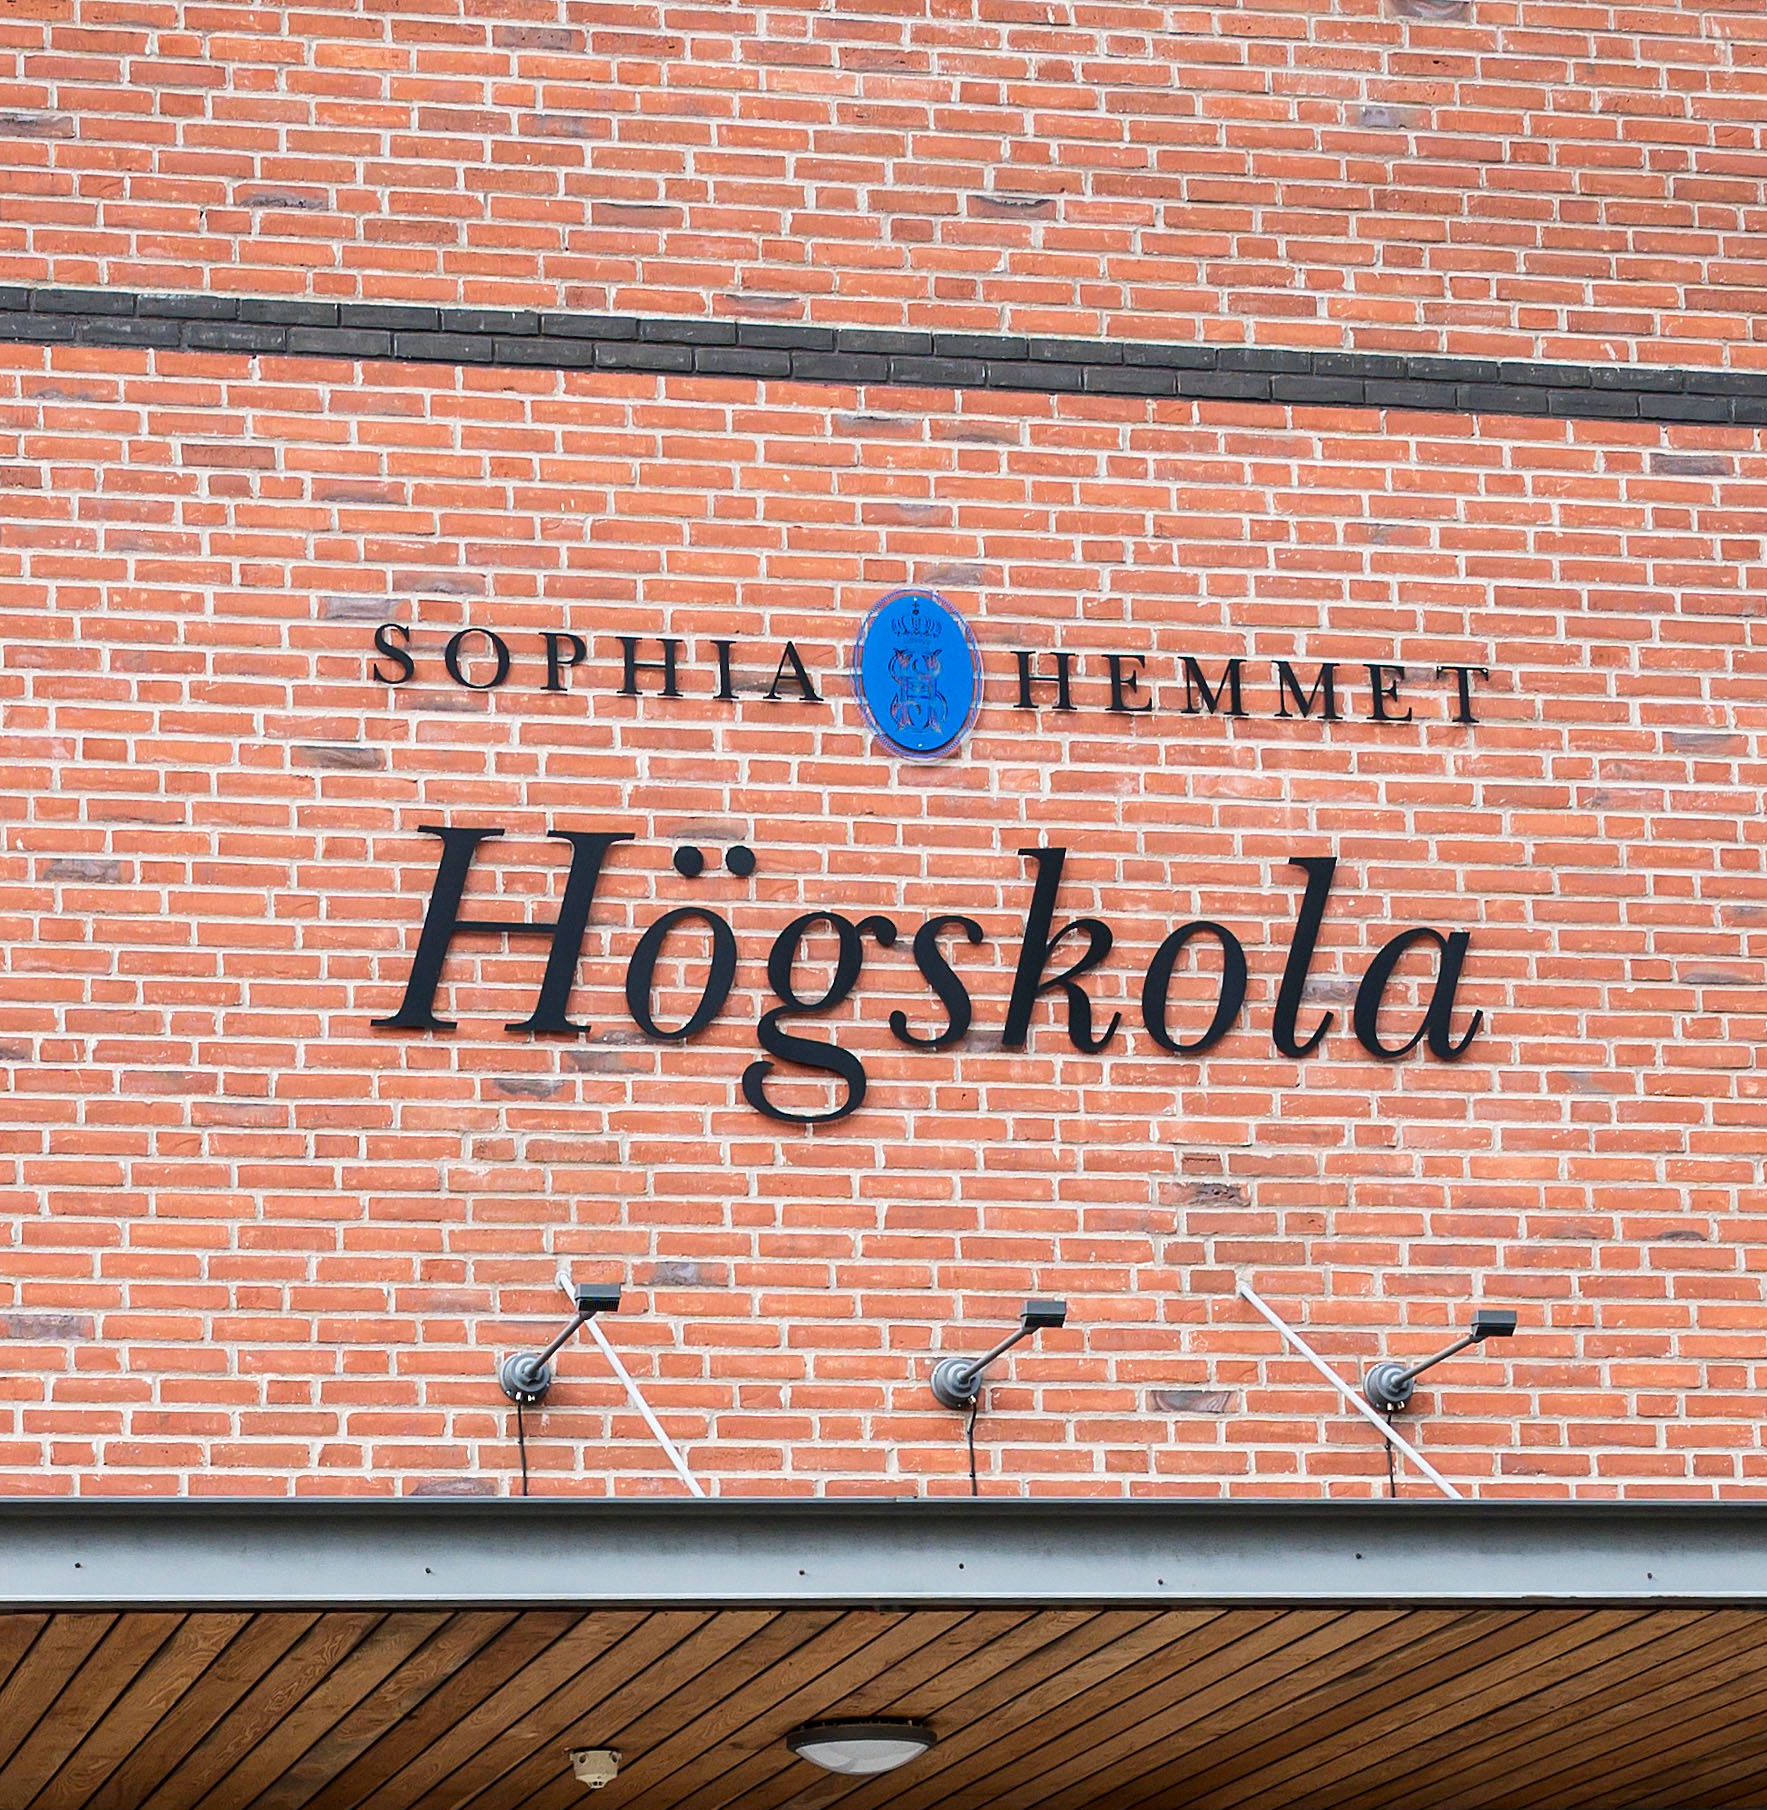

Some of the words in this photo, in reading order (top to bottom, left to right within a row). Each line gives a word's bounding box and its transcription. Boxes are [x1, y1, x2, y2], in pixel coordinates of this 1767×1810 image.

[371, 621, 824, 705] SOPHIA
[1011, 648, 1492, 726] HEMMET
[369, 823, 1486, 1126] Högskola
